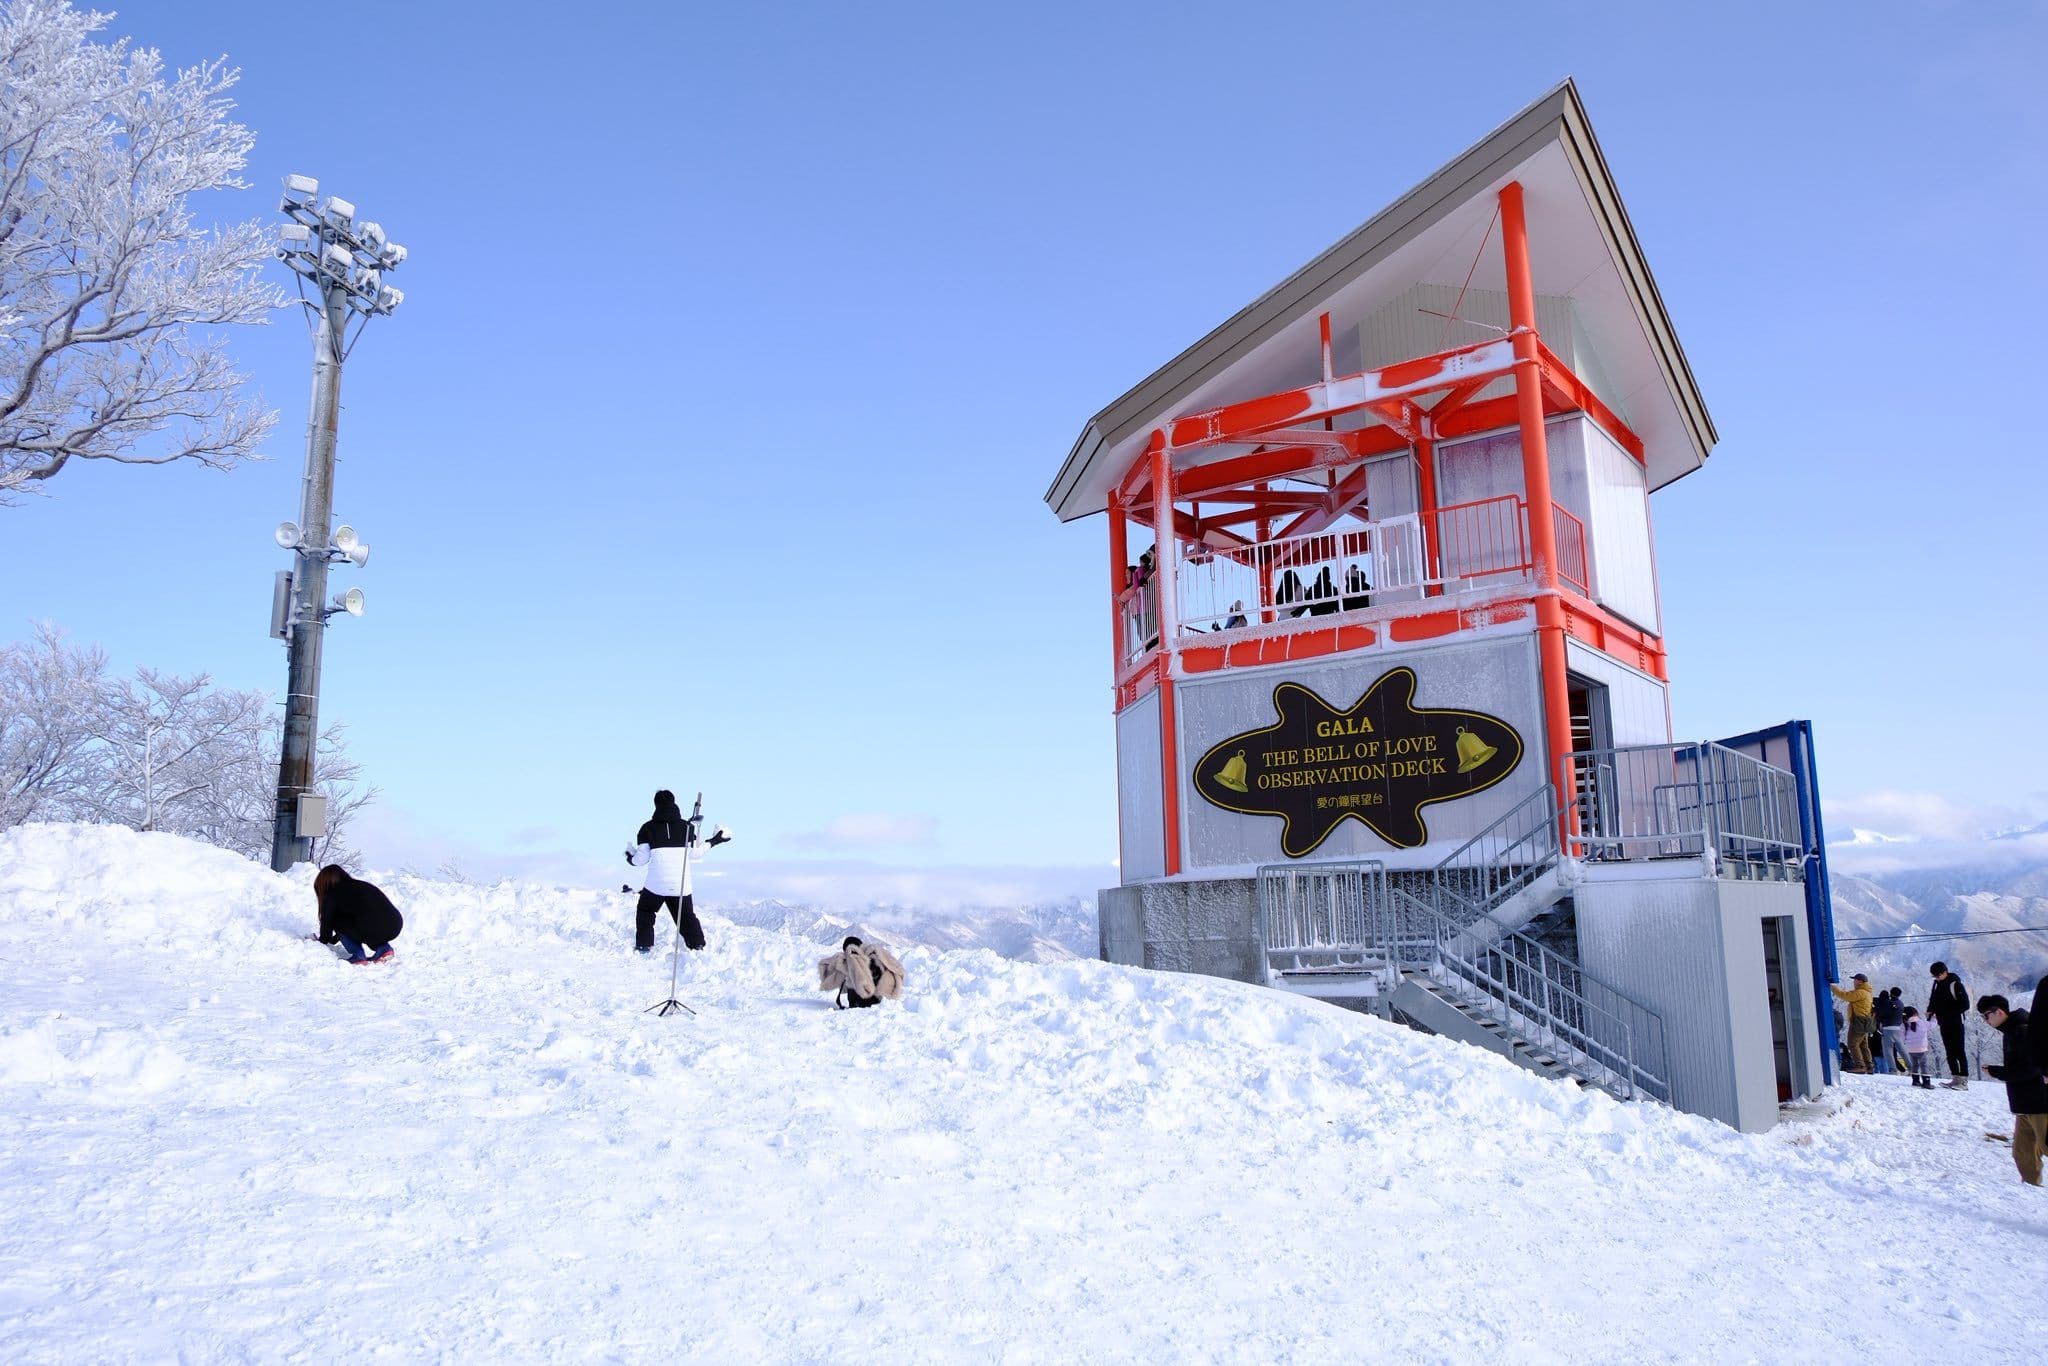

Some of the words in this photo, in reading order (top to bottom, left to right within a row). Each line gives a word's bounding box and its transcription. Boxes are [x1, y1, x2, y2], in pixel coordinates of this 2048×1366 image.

[1316, 716, 1374, 738] GALA
[1262, 749, 1299, 767] THE
[1302, 744, 1351, 764] BELL
[1354, 741, 1380, 758] OF
[1384, 735, 1437, 756] LOVE
[1257, 763, 1386, 790] OBSERVATION
[1390, 757, 1447, 778] DECK
